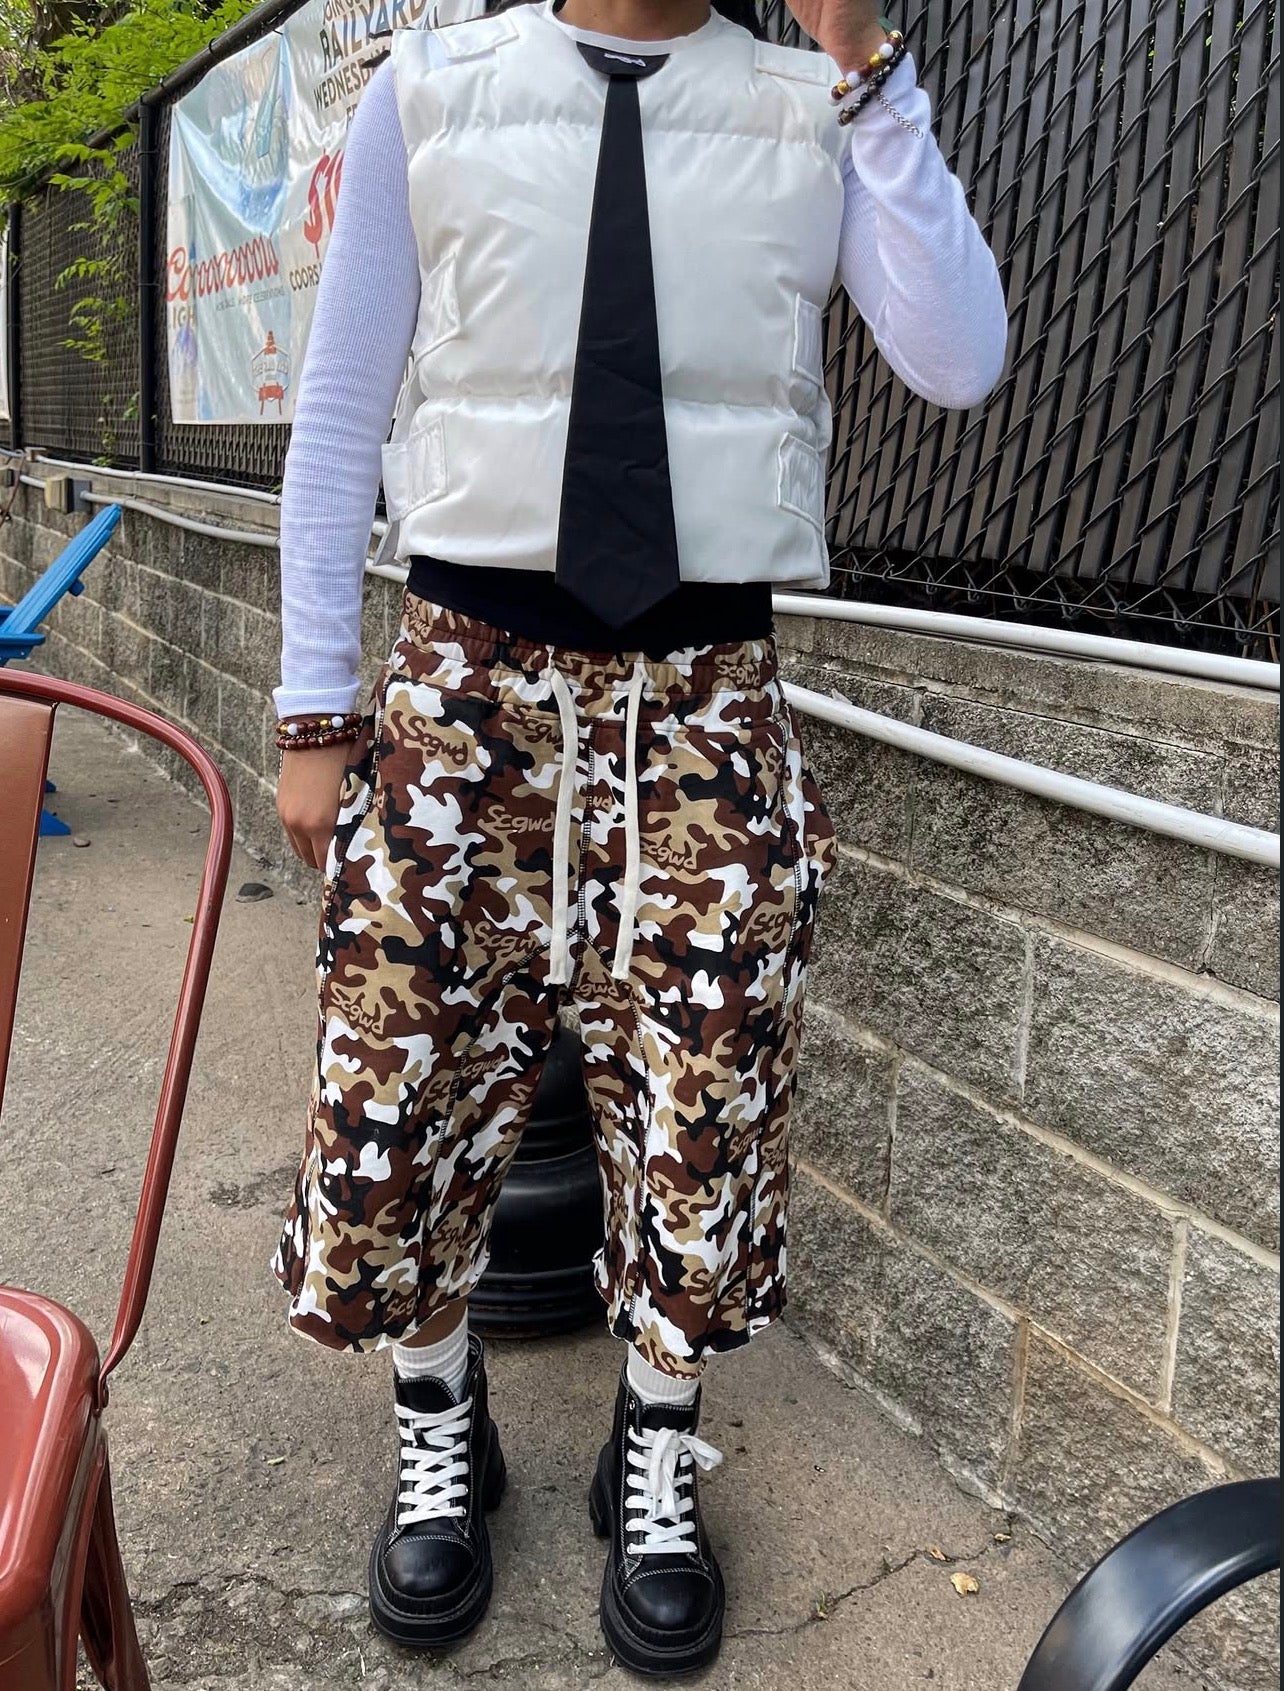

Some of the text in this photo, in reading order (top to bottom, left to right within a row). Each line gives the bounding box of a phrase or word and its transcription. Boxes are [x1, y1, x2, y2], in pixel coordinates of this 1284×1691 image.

[319, 0, 427, 74] RAILYARD
[313, 47, 386, 112] WEDNESD
[289, 264, 320, 292] COORS
[408, 714, 469, 766] Scgwd
[473, 920, 537, 958] Scgw
[331, 984, 385, 1035] Scgwd
